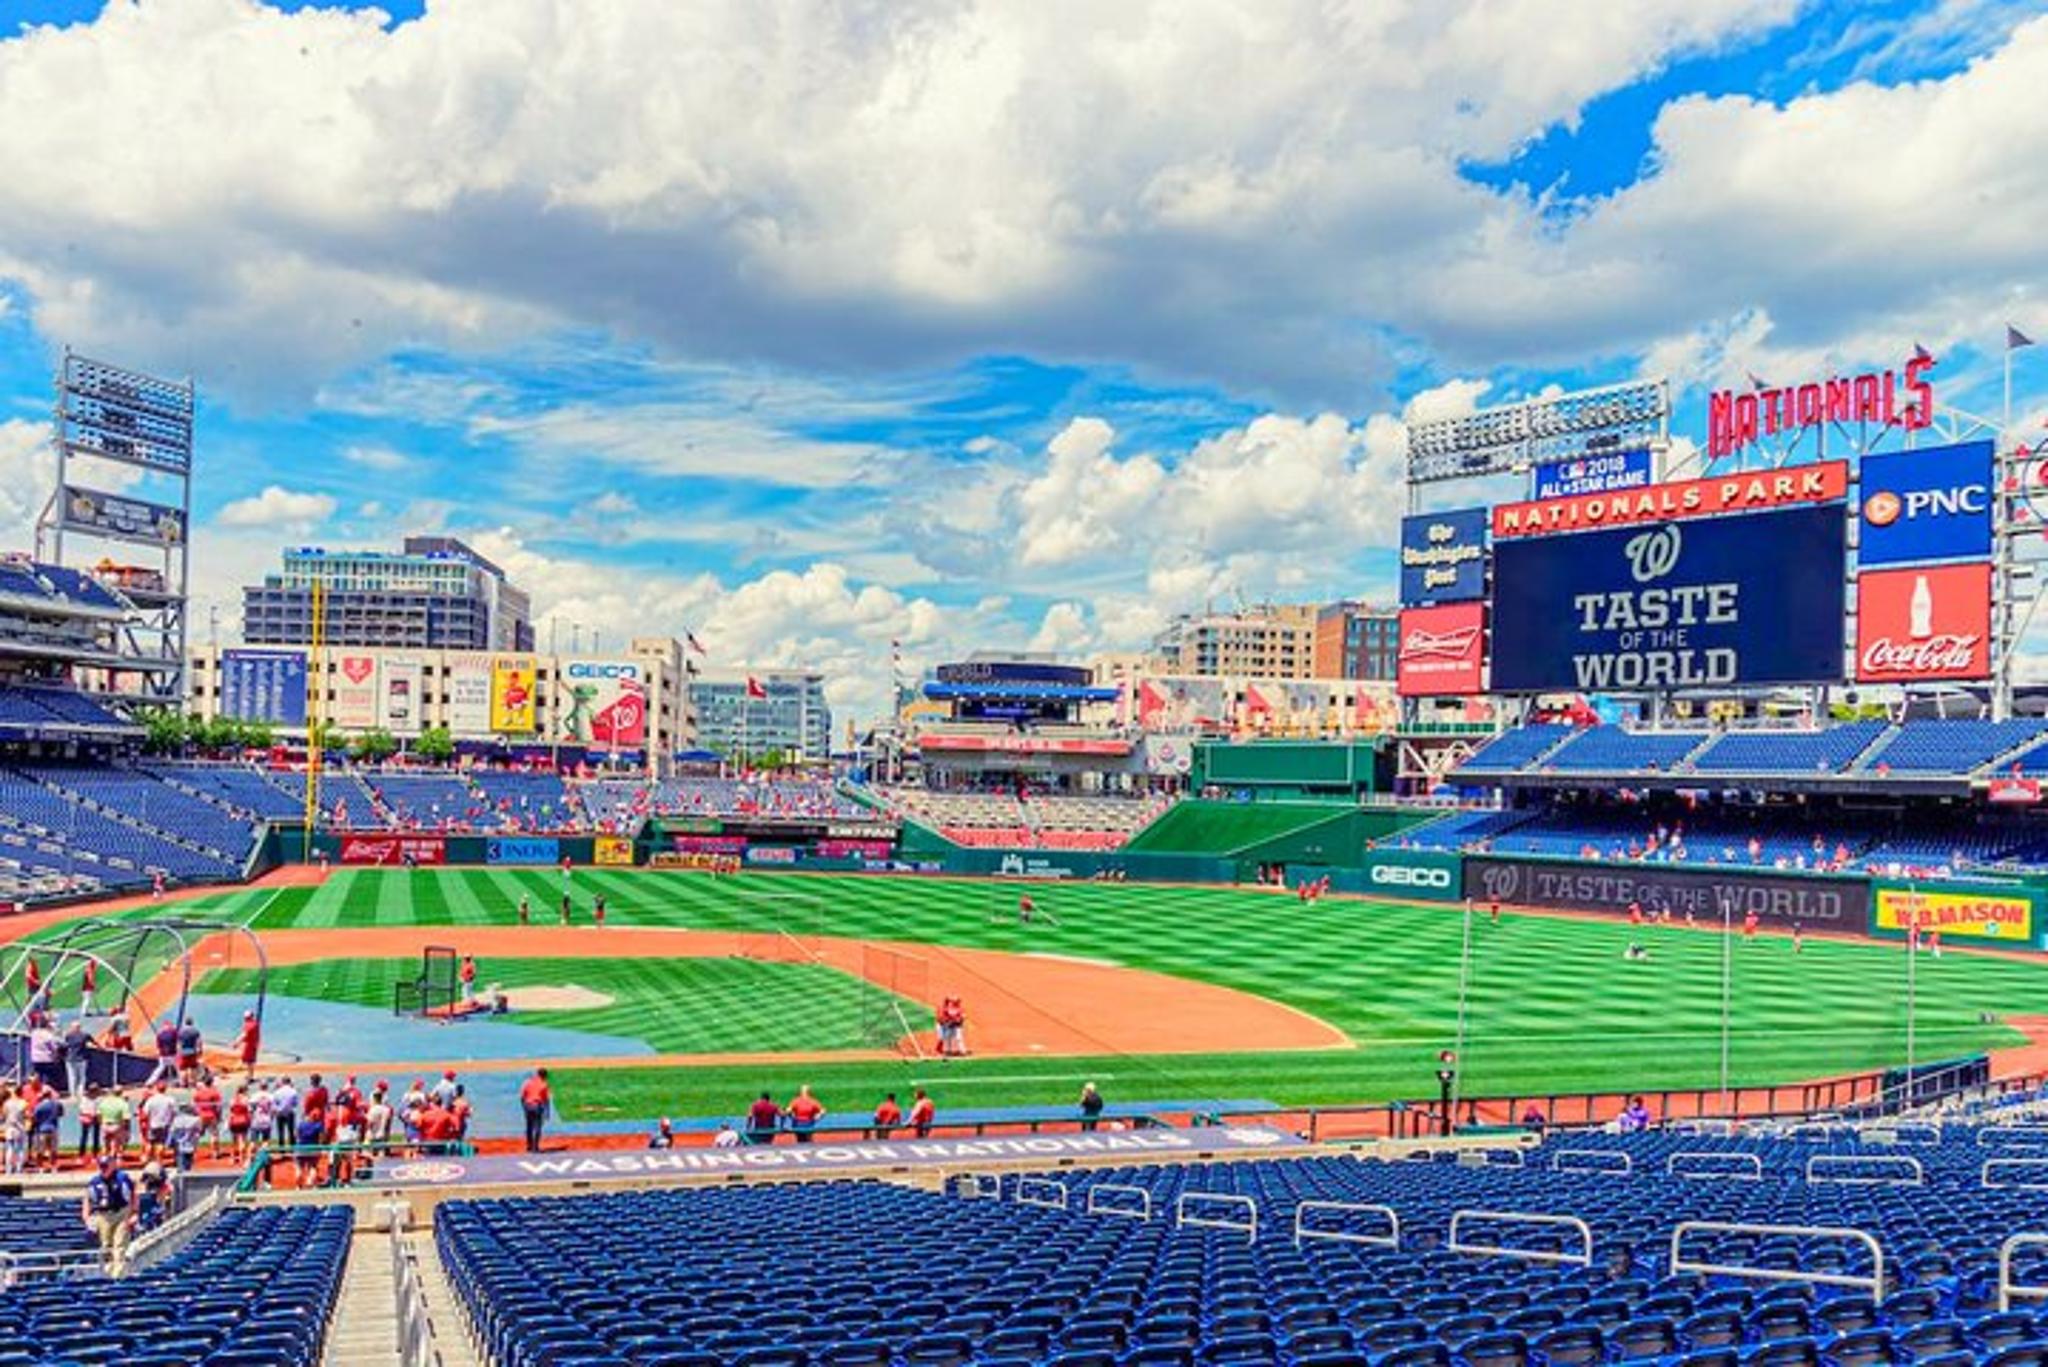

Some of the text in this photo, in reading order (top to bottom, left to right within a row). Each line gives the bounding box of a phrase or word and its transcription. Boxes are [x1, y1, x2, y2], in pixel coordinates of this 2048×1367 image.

[1707, 355, 1937, 459] NATIONALS
[1540, 481, 1563, 498] ALL
[1606, 469, 1646, 489] GAME
[1587, 456, 1625, 476] 2018
[1502, 471, 1825, 529] NATIONALS PARK
[1904, 485, 1986, 518] PNC
[1574, 584, 1739, 631] TASTE
[1620, 629, 1687, 650] OF THE
[1863, 634, 1980, 671] Coca-Cola
[569, 663, 637, 678] GEICO
[1573, 648, 1737, 688] WORLD
[1371, 864, 1450, 888] GEICO
[1538, 873, 1634, 905] TASTE
[1638, 885, 1663, 904] OF
[1671, 887, 1709, 909] THE
[1712, 884, 1842, 919] WORLD
[520, 1141, 900, 1175] WASHINGTON
[907, 1131, 1192, 1159] NATIONALS
